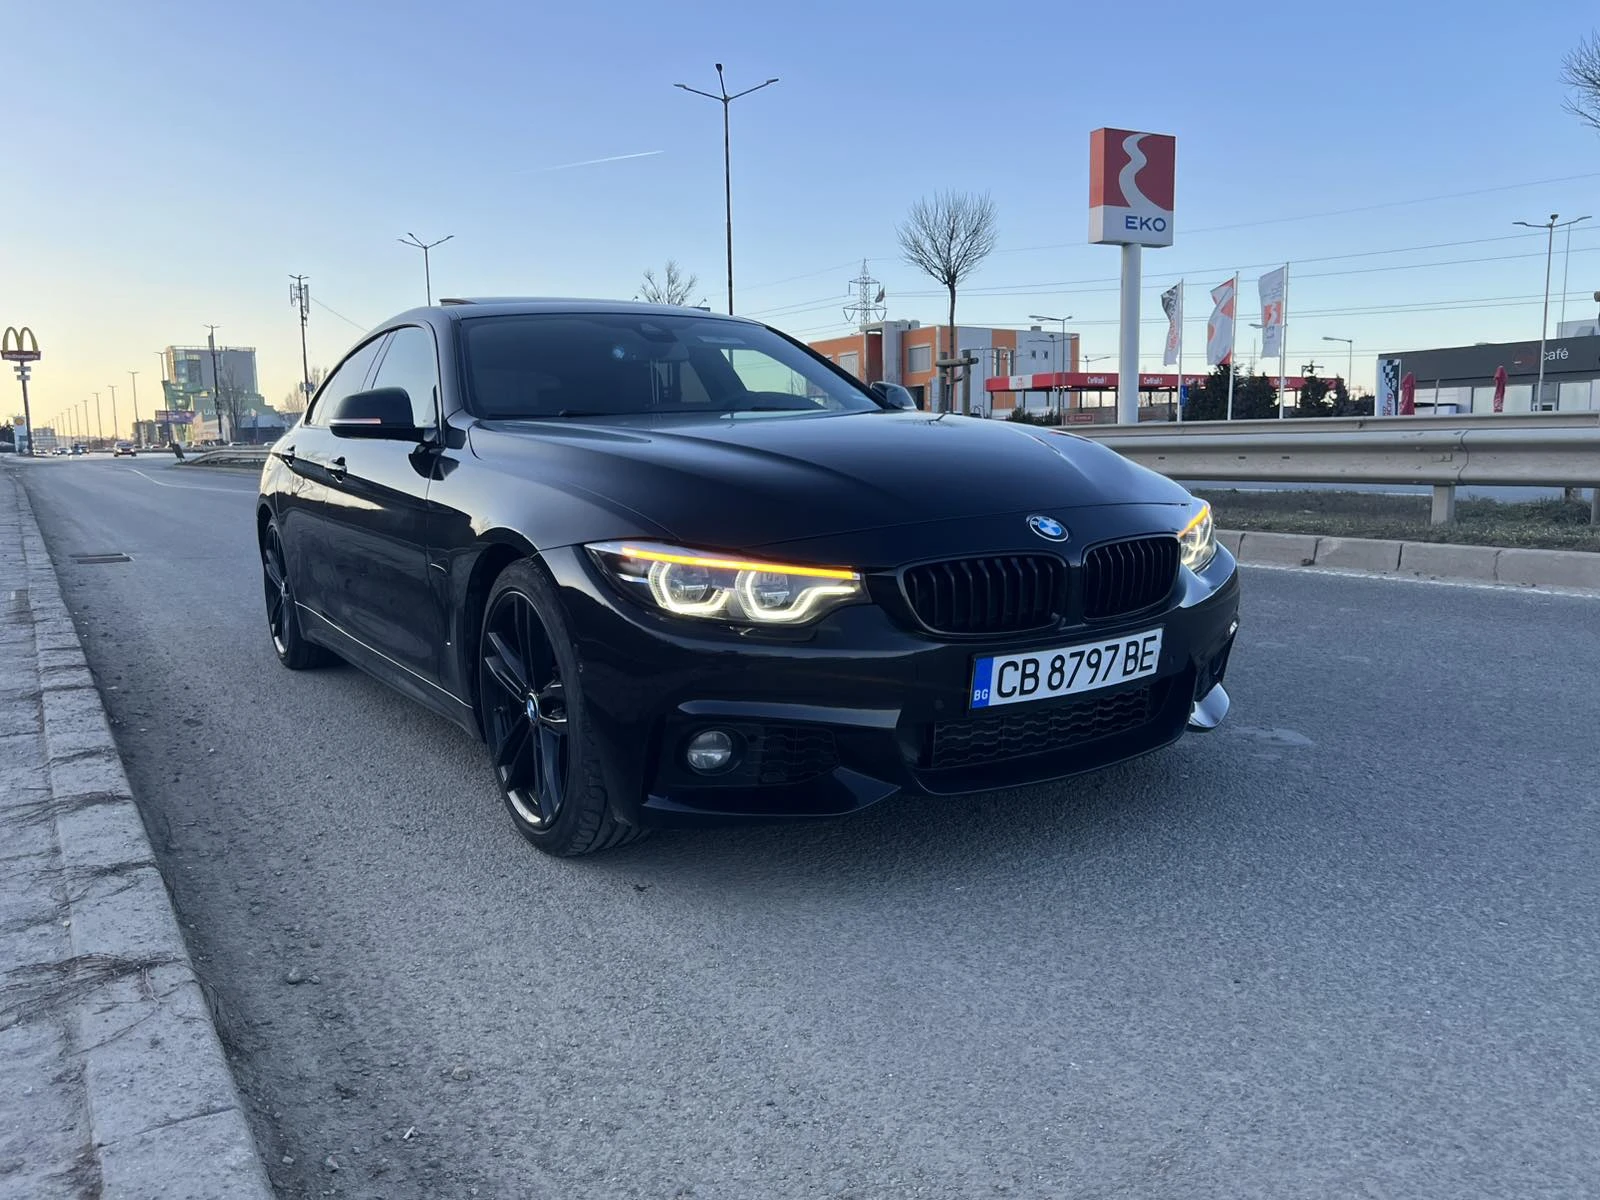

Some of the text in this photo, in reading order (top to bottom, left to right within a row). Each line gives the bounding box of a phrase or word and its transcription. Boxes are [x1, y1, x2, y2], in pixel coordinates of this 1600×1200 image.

[1125, 215, 1167, 233] EKO
[1544, 348, 1569, 361] café
[996, 635, 1157, 698] CB 8797 BE
[974, 689, 988, 701] BG
